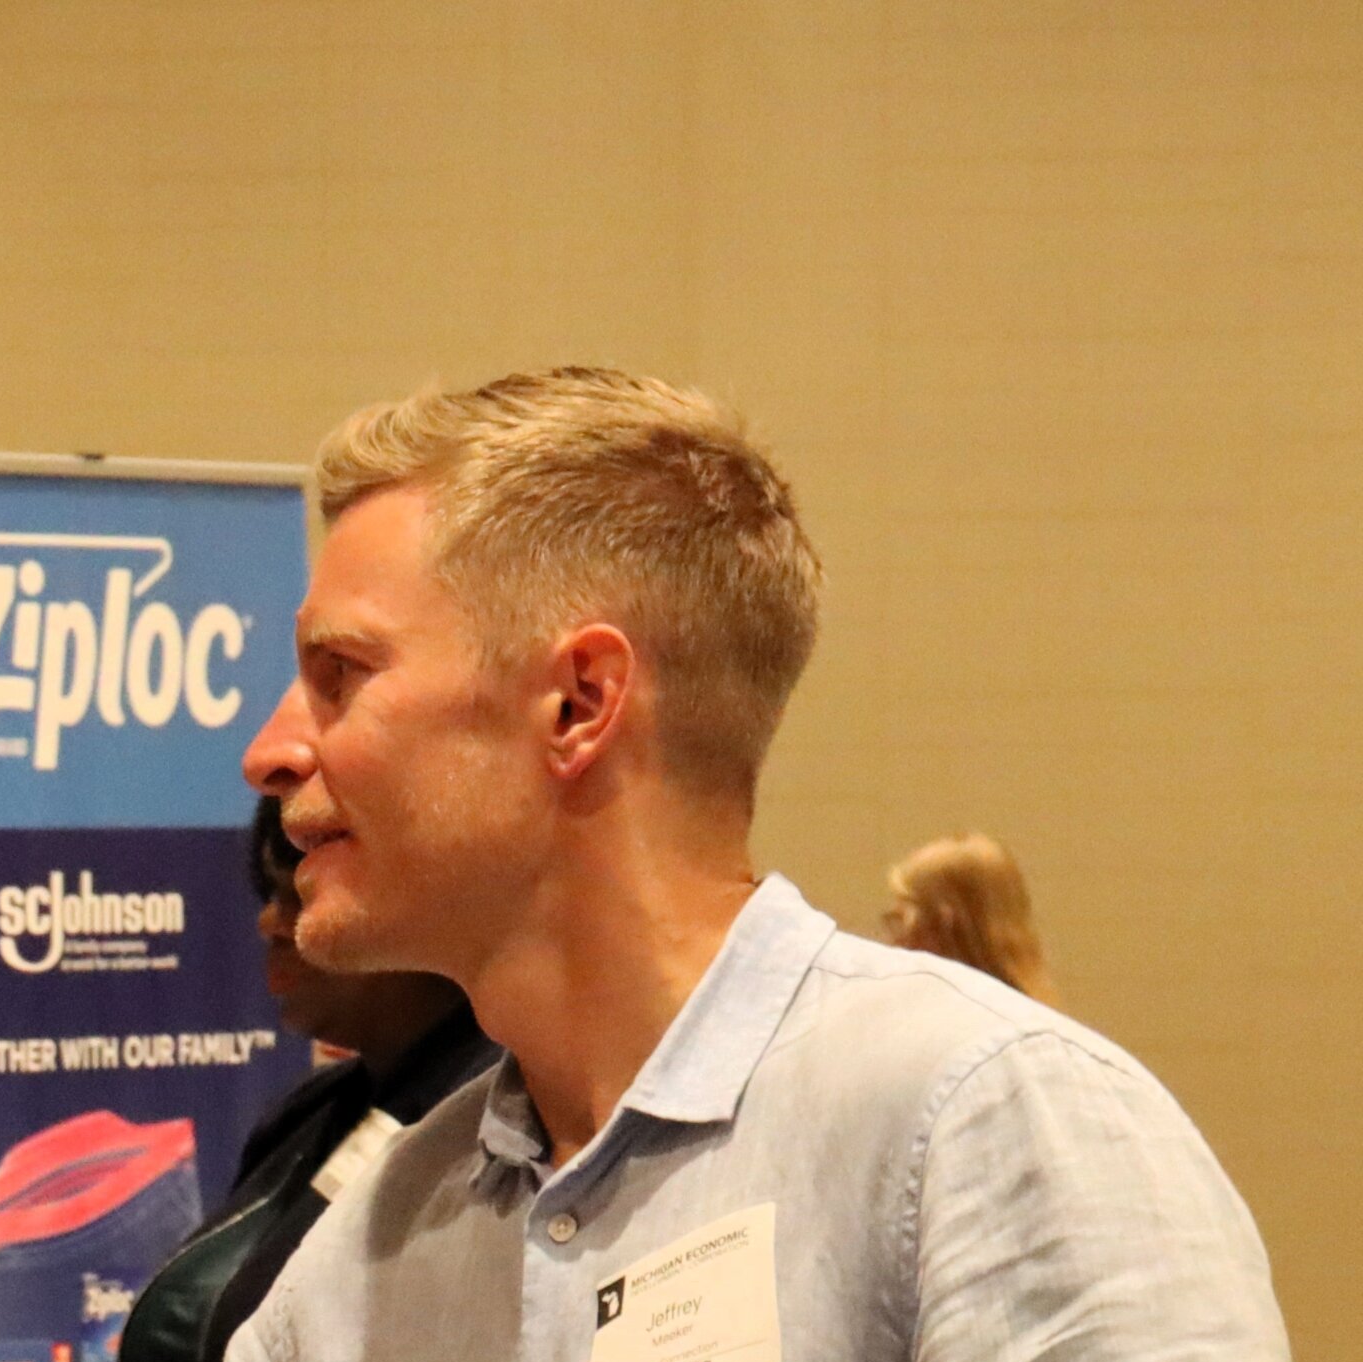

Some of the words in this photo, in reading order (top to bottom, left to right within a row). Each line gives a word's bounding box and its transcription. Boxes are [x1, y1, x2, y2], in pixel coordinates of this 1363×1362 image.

[60, 1035, 120, 1071] WITH
[123, 1033, 176, 1069] OUR
[685, 1227, 749, 1261] ECONOMIC
[646, 1295, 703, 1332] Jeffrey
